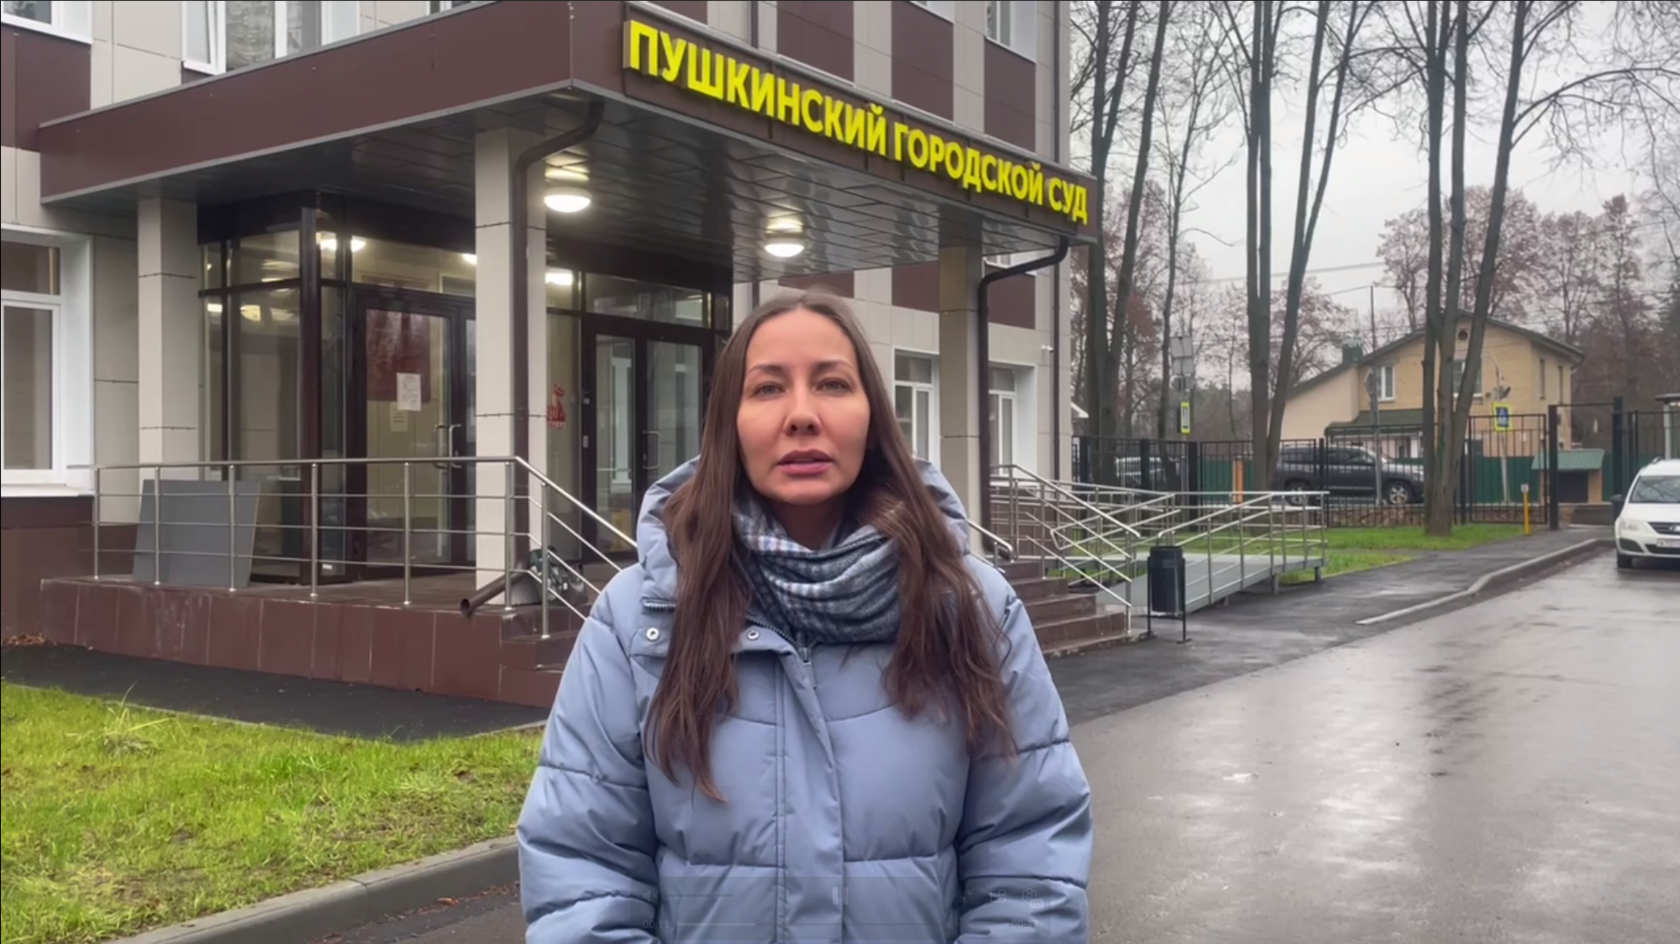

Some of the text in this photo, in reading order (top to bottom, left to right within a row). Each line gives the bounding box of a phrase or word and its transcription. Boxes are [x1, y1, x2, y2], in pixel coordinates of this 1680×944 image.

[627, 20, 1088, 225] ПУШКИНСКИЙ ГОРОДСКОЙ СУД
